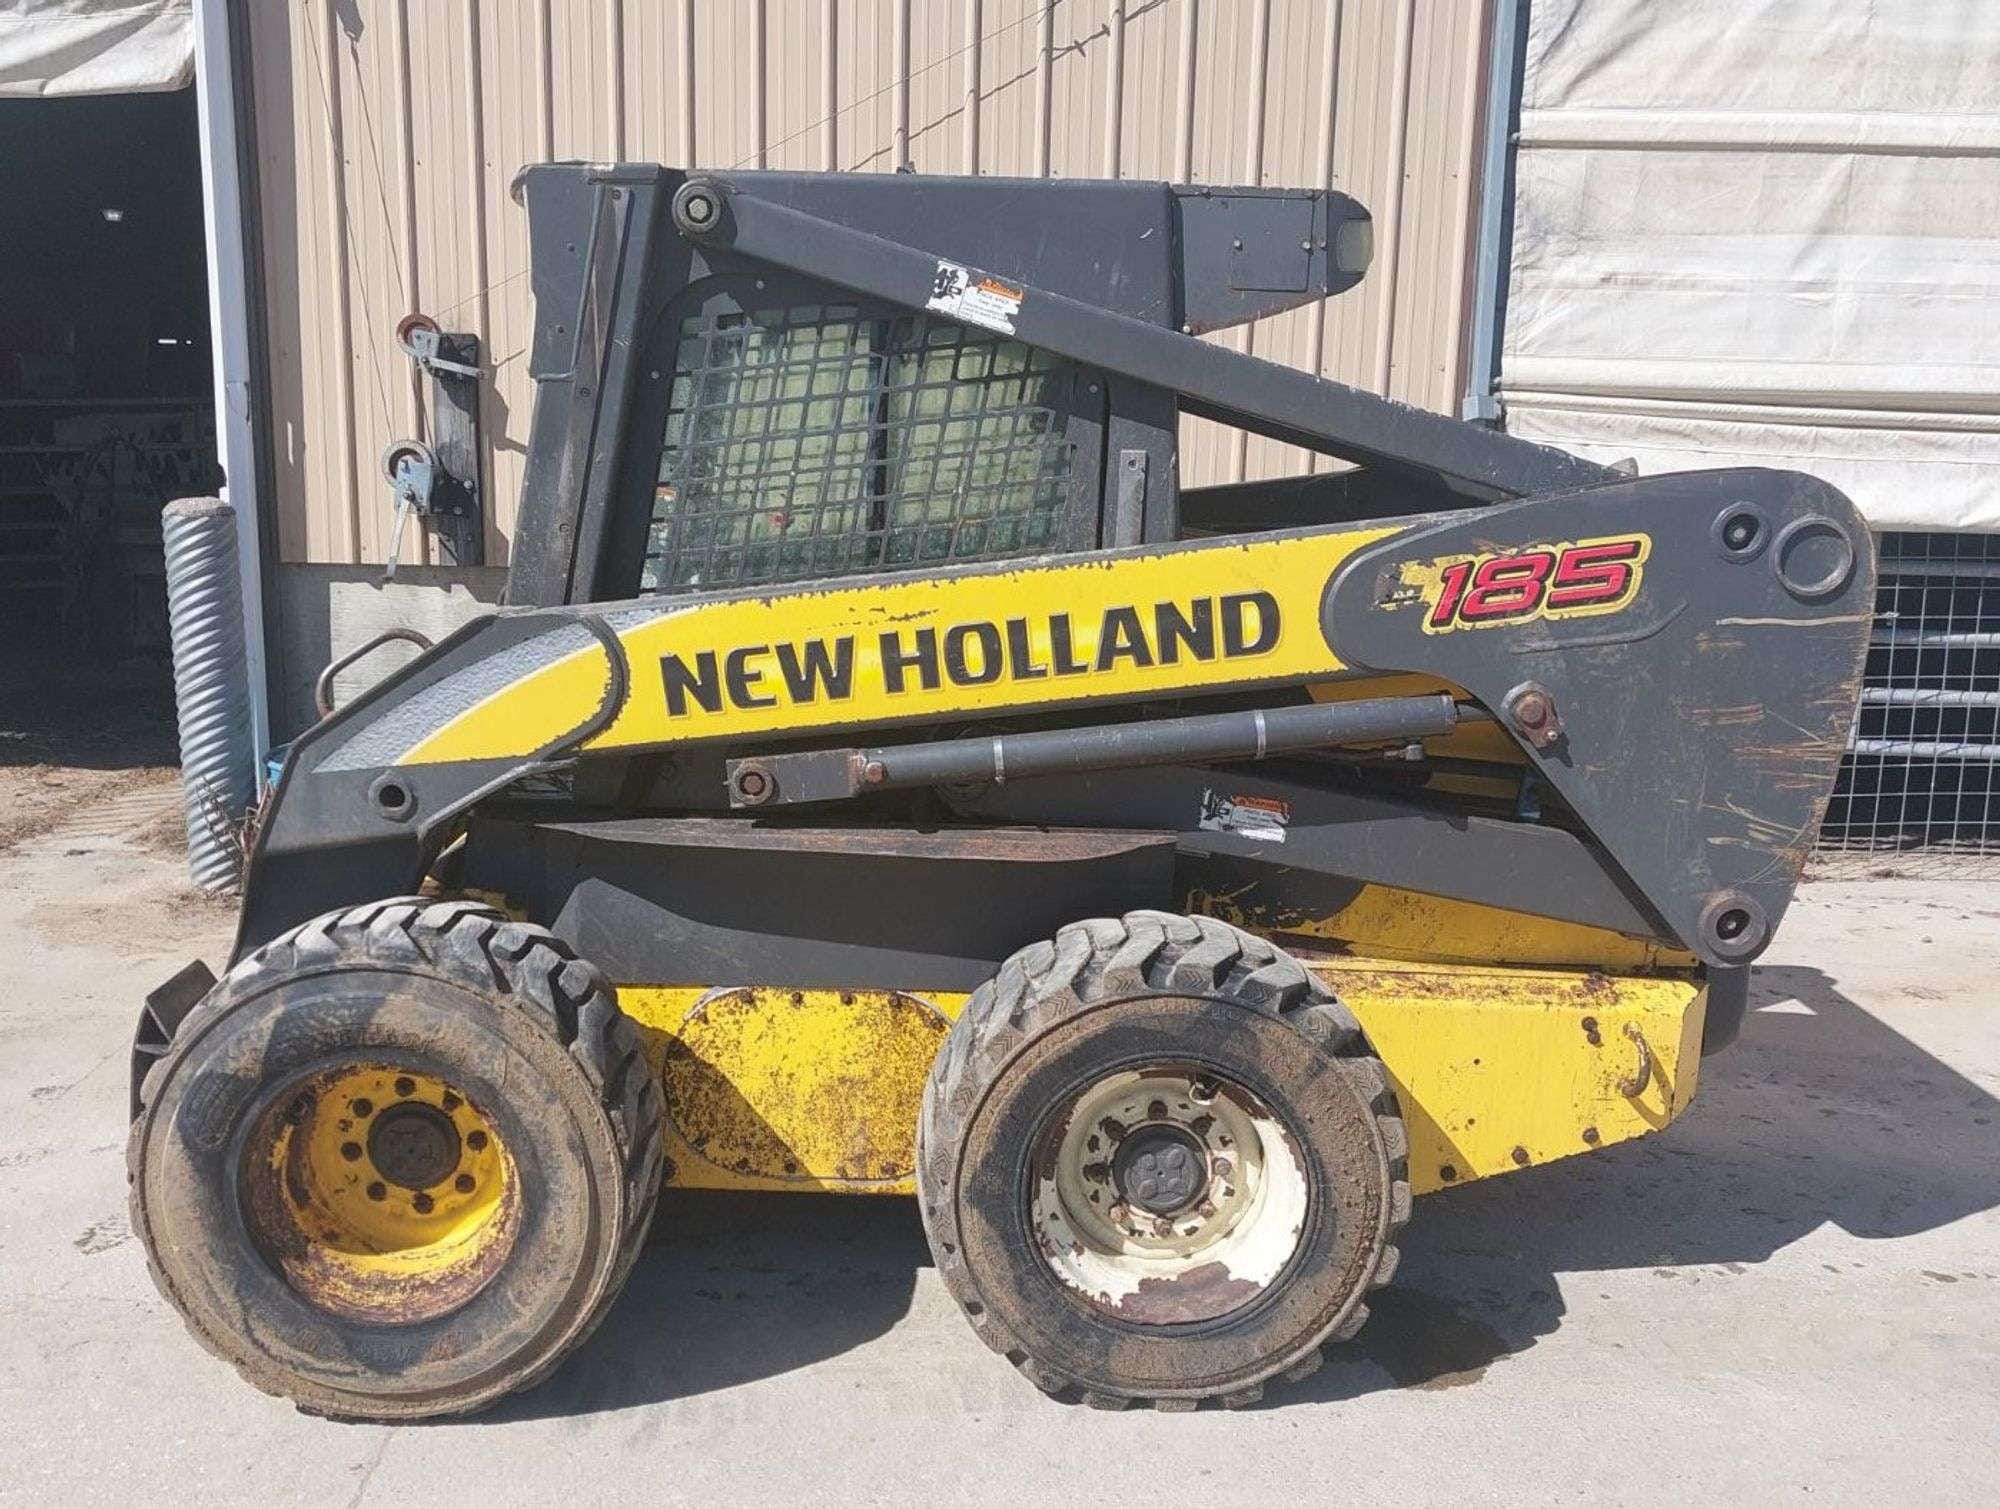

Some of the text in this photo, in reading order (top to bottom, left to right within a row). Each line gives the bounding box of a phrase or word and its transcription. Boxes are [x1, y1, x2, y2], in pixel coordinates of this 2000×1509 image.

[1429, 540, 1642, 628] 185
[659, 588, 1282, 717] NEW HOLLAND
